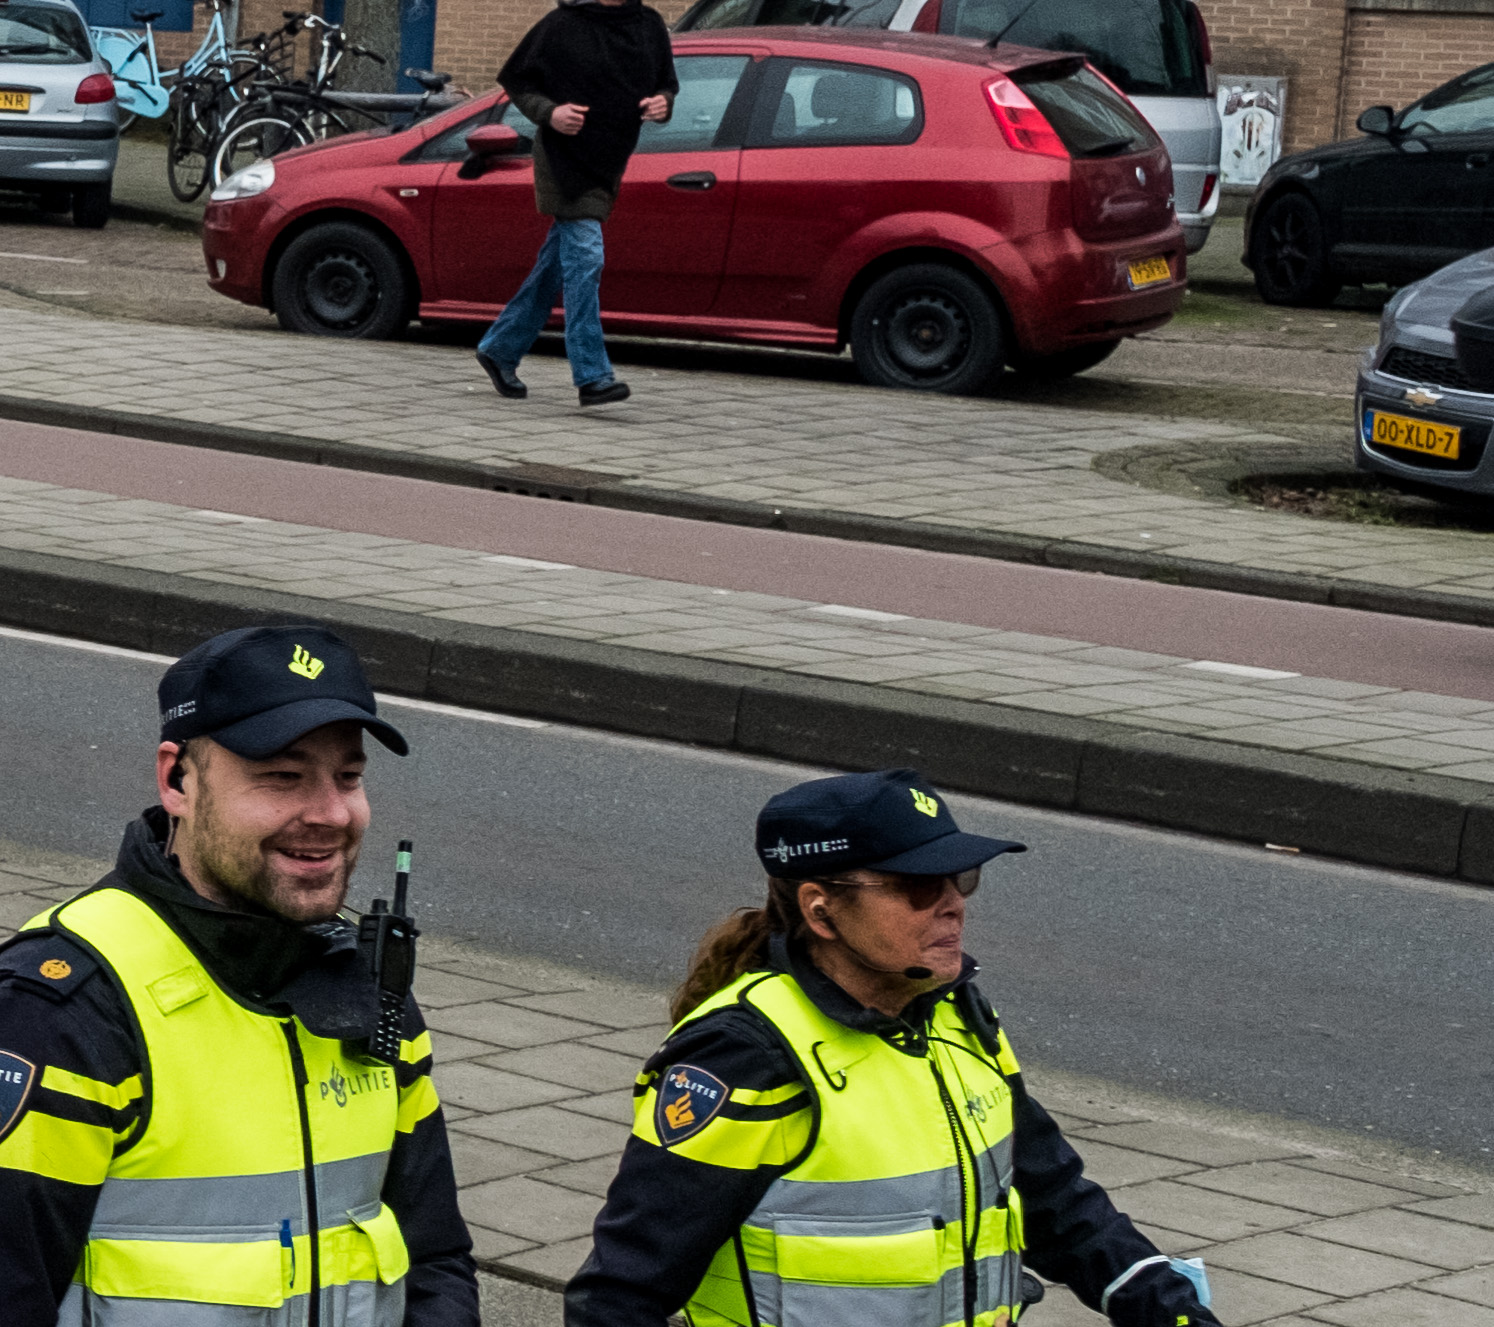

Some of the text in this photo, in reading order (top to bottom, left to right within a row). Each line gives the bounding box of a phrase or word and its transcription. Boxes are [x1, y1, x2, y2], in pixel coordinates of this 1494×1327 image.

[1377, 417, 1455, 454] 00-XLD-7
[320, 1069, 391, 1108] POLITIE
[669, 1073, 718, 1099] POLITIE
